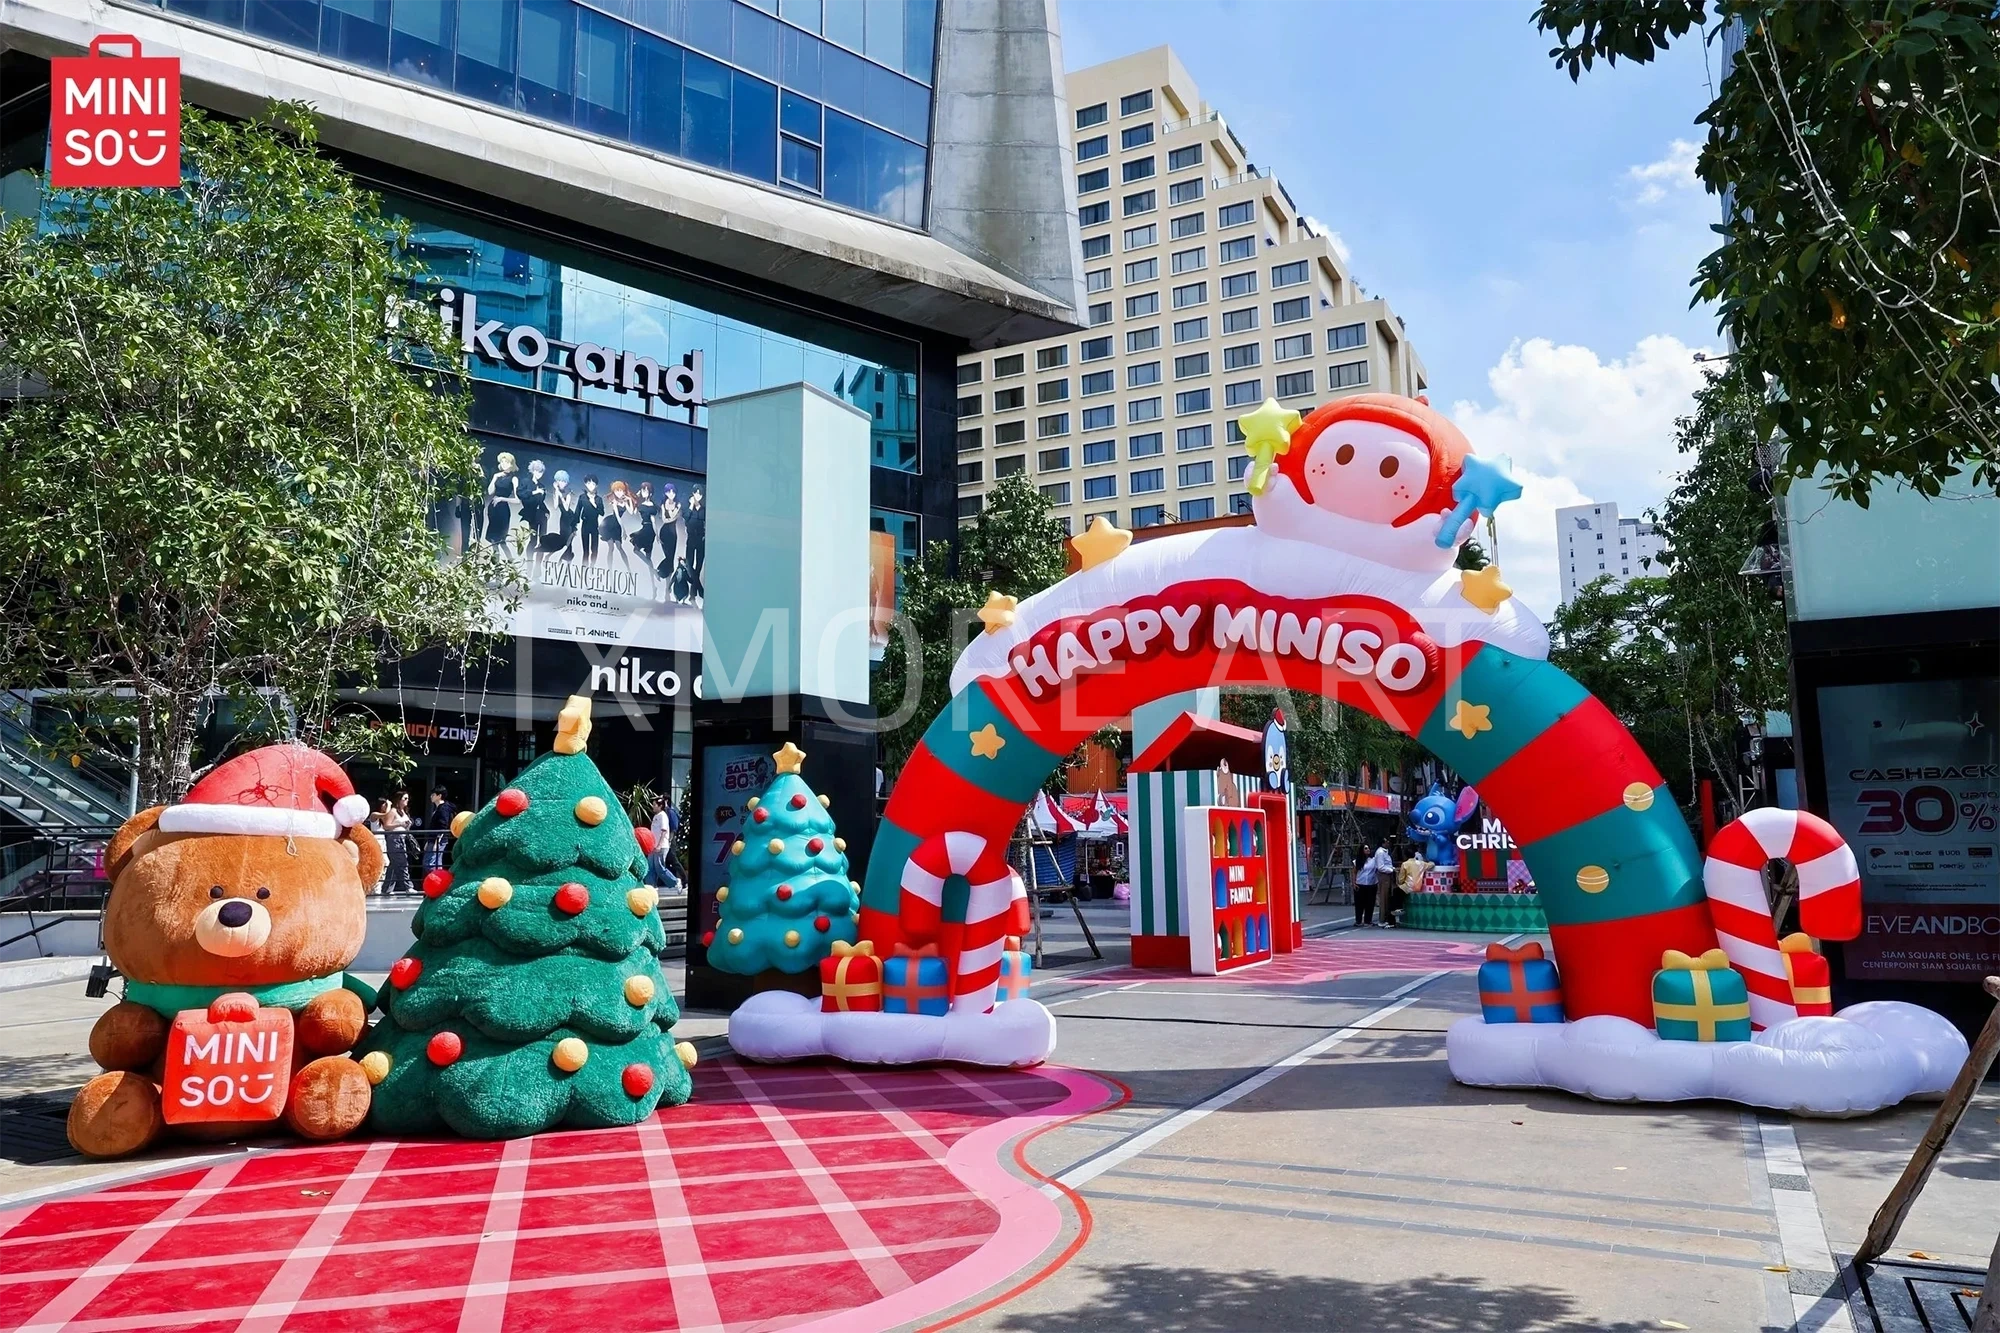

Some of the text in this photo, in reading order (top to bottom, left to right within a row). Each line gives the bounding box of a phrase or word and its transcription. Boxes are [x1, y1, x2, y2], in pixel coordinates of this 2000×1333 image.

[574, 341, 704, 405] and
[541, 560, 638, 597] EVANGELION
[566, 597, 588, 607] niko
[589, 600, 608, 610] and
[583, 593, 602, 601] meets
[1012, 603, 1428, 698] HAPPY MINISO
[590, 656, 681, 697] niko
[439, 726, 478, 741] ZONE
[726, 761, 757, 774] SALE
[1848, 764, 1999, 781] CASHBACK
[1482, 817, 1508, 834] M
[1229, 865, 1245, 882] MINI
[1229, 886, 1253, 905] FAMILY
[1881, 950, 1906, 959] SIAM
[1908, 951, 1947, 960] SQUARE
[1976, 952, 1990, 961] LG
[1862, 961, 1919, 970] CENTERPOINT
[1921, 962, 1945, 970] SIAM
[1946, 963, 1981, 971] SQUARE
[183, 1031, 279, 1066] MINI
